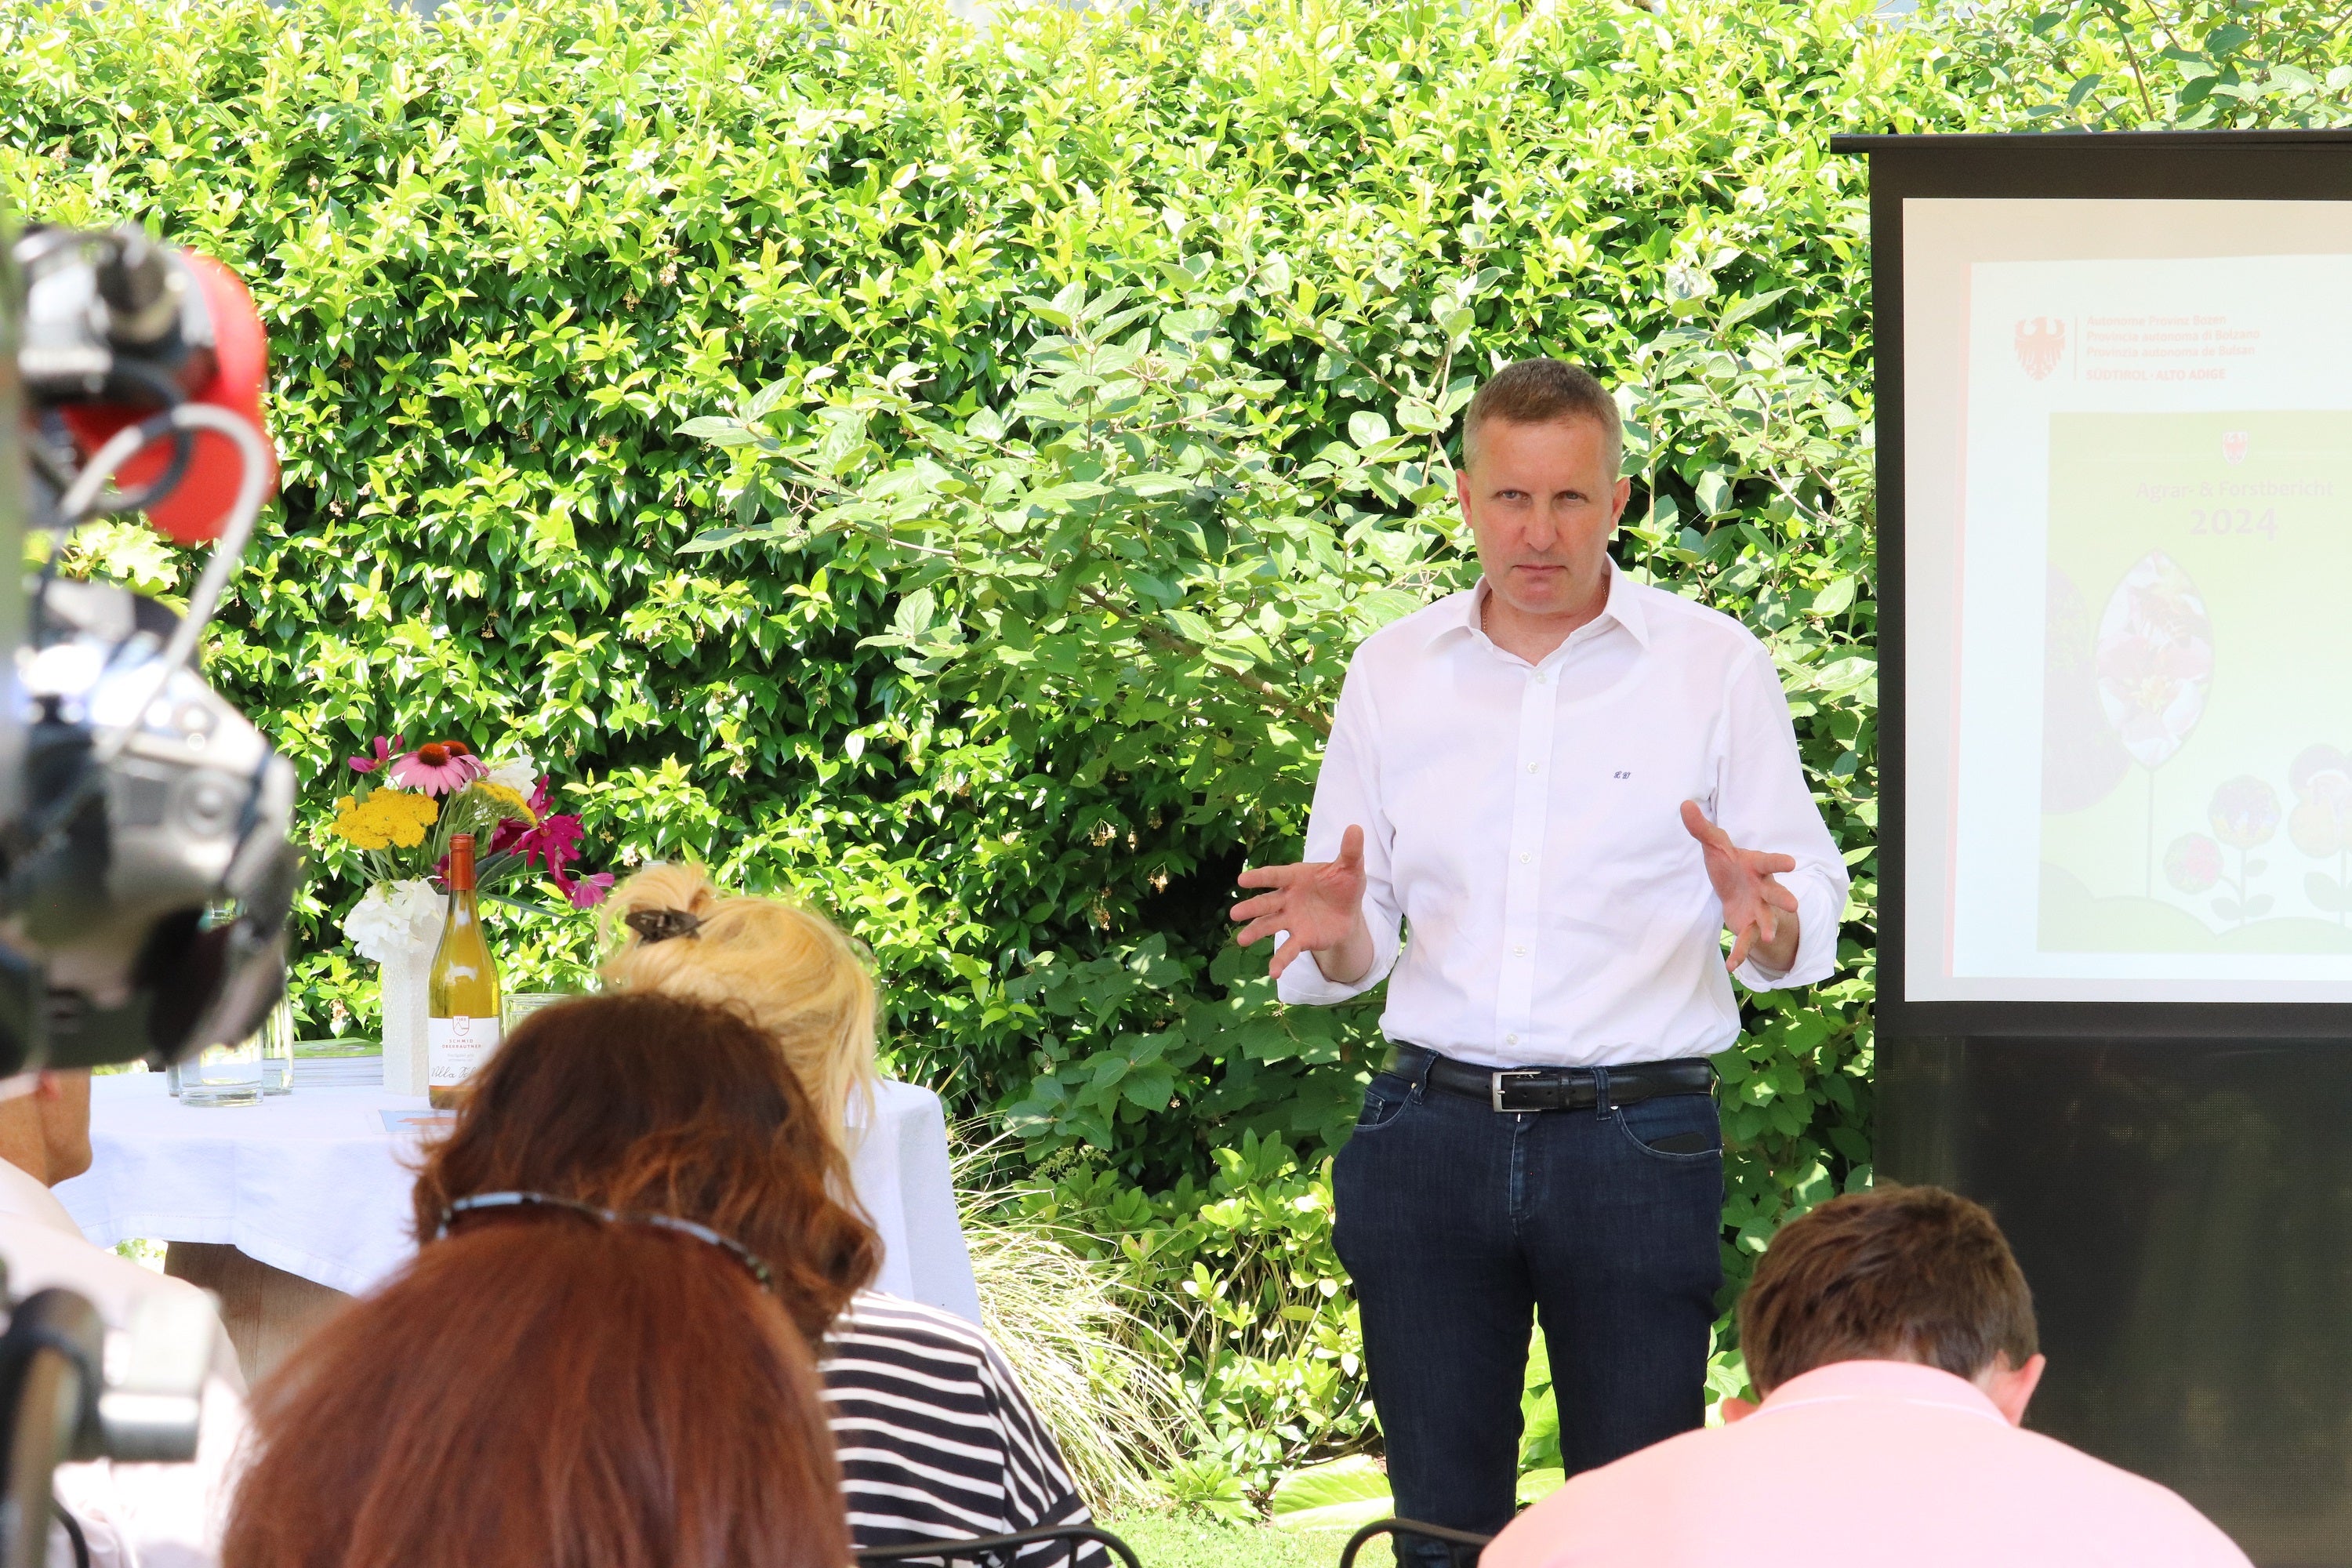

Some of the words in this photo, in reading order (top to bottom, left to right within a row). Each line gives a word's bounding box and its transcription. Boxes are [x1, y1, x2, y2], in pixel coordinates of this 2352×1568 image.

[2087, 315, 2145, 326] Autonome
[2149, 315, 2190, 326] Provinz
[2193, 315, 2227, 326] Bozen
[2086, 330, 2139, 342] Provincia
[2142, 331, 2198, 342] autonoma
[2202, 329, 2212, 340] di
[2216, 328, 2260, 340] Bolzano
[2086, 347, 2139, 358] Provinzia
[2141, 347, 2198, 358] autonoma
[2201, 345, 2215, 357] de
[2219, 344, 2255, 356] Bulsan
[2086, 368, 2148, 381] SÜDTIROL
[2155, 369, 2185, 381] ALTO
[2189, 368, 2227, 380] ADIGE
[2136, 481, 2195, 503] Agrar-
[2199, 481, 2213, 497] &
[2219, 479, 2335, 497] Forstbericht
[2189, 507, 2279, 541] 2024
